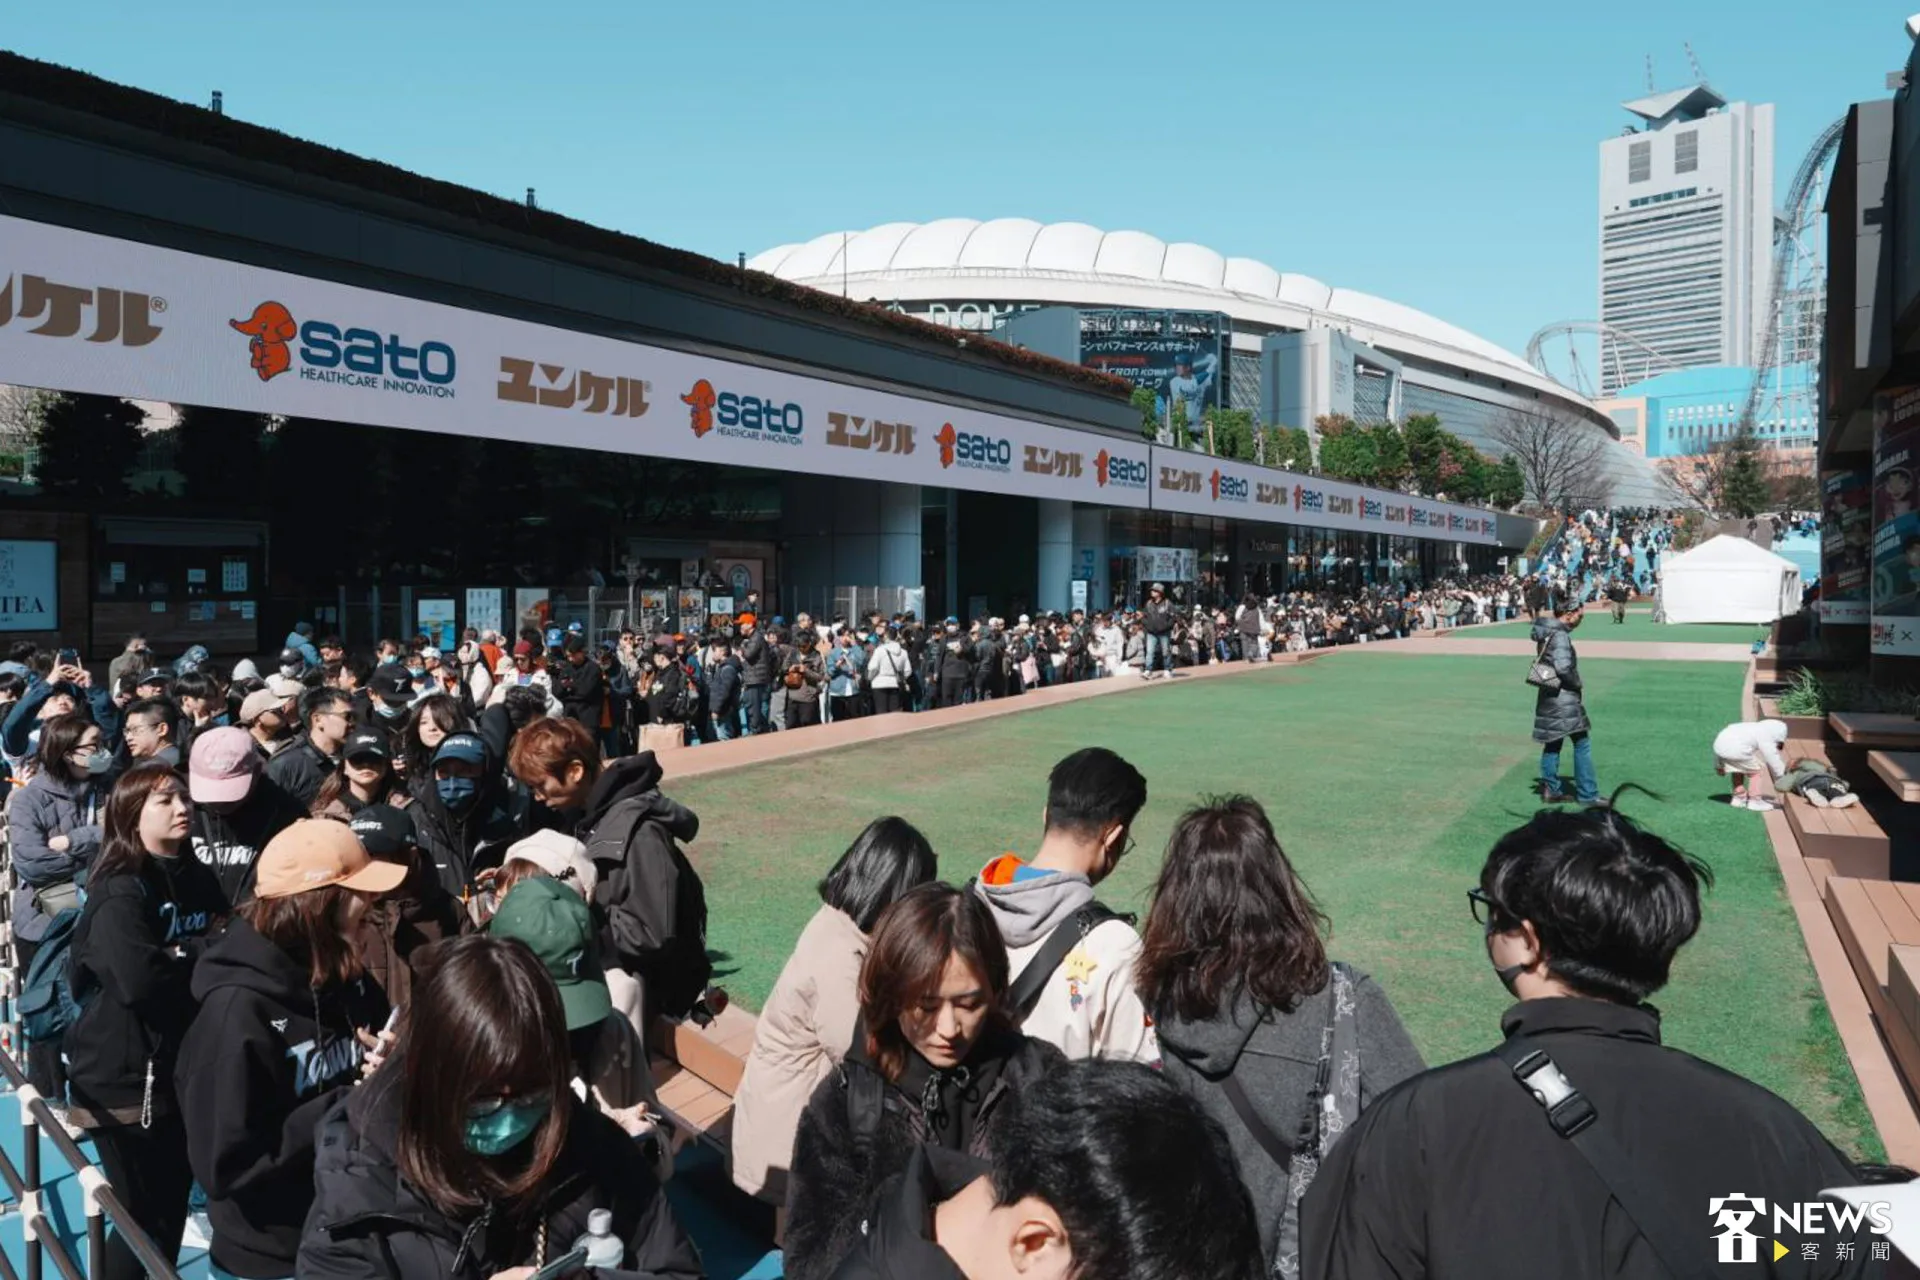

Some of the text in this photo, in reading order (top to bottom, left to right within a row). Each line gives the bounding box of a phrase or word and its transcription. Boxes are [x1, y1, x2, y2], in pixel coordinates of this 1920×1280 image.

[929, 302, 1041, 331] DOM
[299, 319, 457, 385] sato
[299, 366, 456, 399] HEALTHCARE INNOVATION
[497, 355, 651, 418] ユンケル
[716, 391, 804, 435] sato
[825, 411, 917, 456] ユンケル
[956, 432, 1011, 465] sato
[1108, 455, 1147, 482] sato
[1219, 475, 1249, 498] sato
